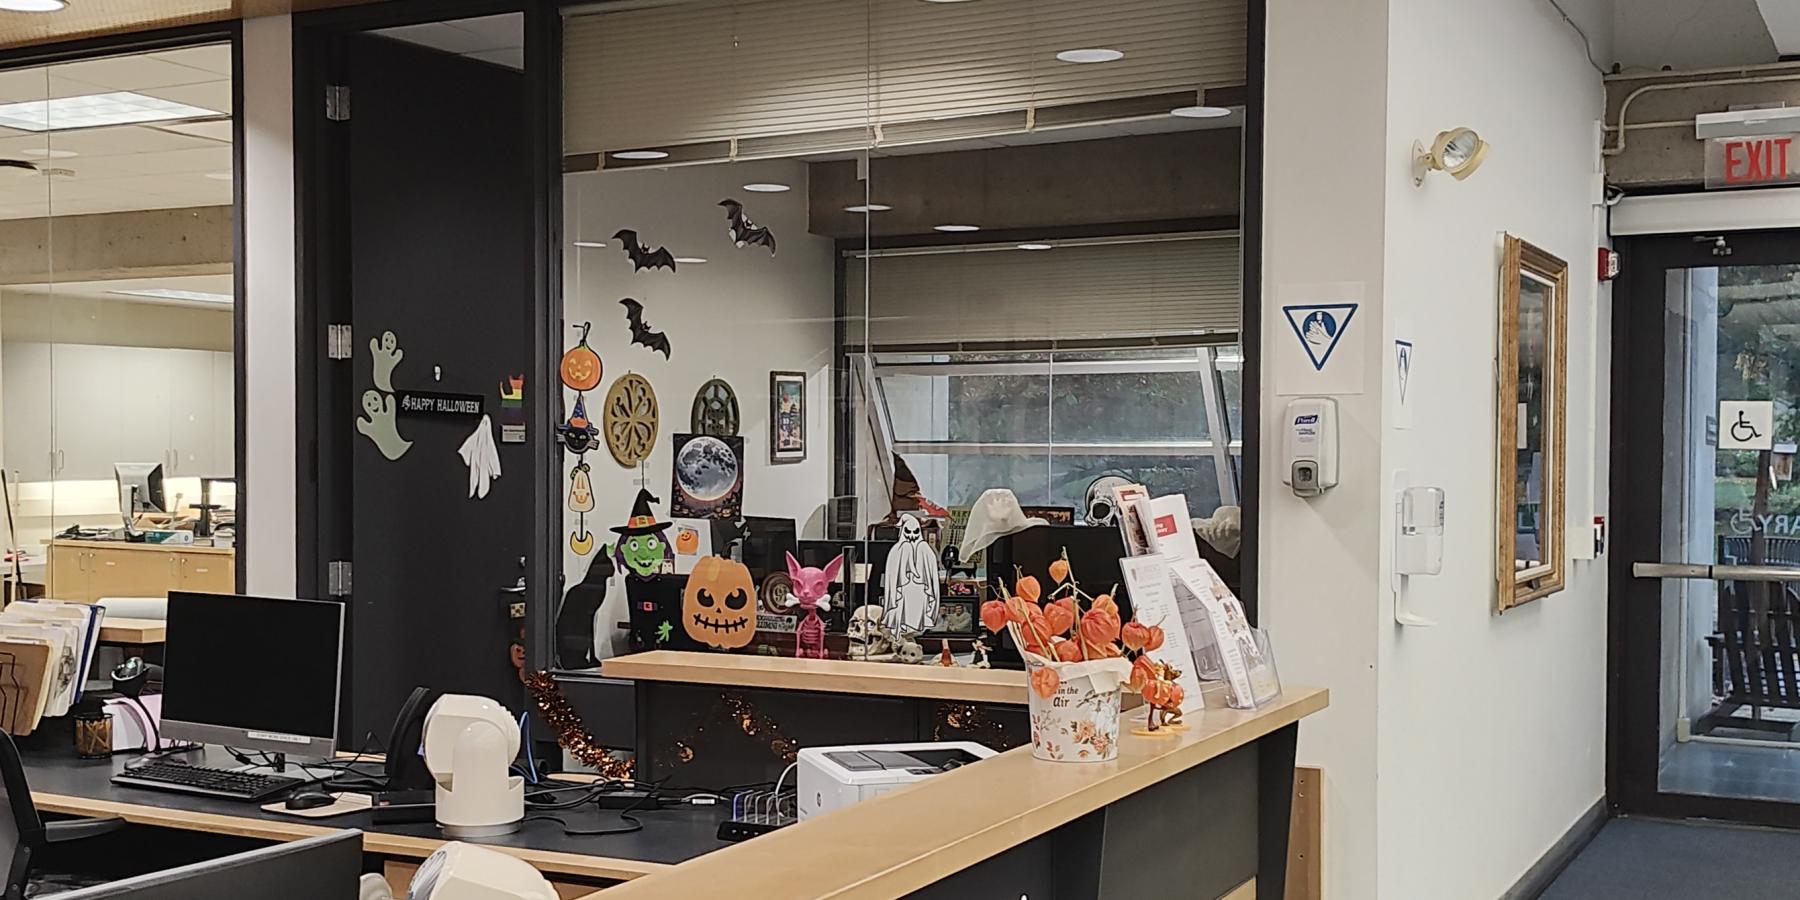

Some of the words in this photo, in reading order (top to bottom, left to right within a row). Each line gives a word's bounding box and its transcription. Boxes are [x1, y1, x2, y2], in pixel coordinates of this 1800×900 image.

[1725, 138, 1792, 185] EXIT
[410, 397, 435, 411] HAPPY
[436, 399, 480, 414] HALLOWEEN
[1058, 687, 1066, 695] in
[1066, 686, 1079, 695] the
[1053, 696, 1070, 708] air
